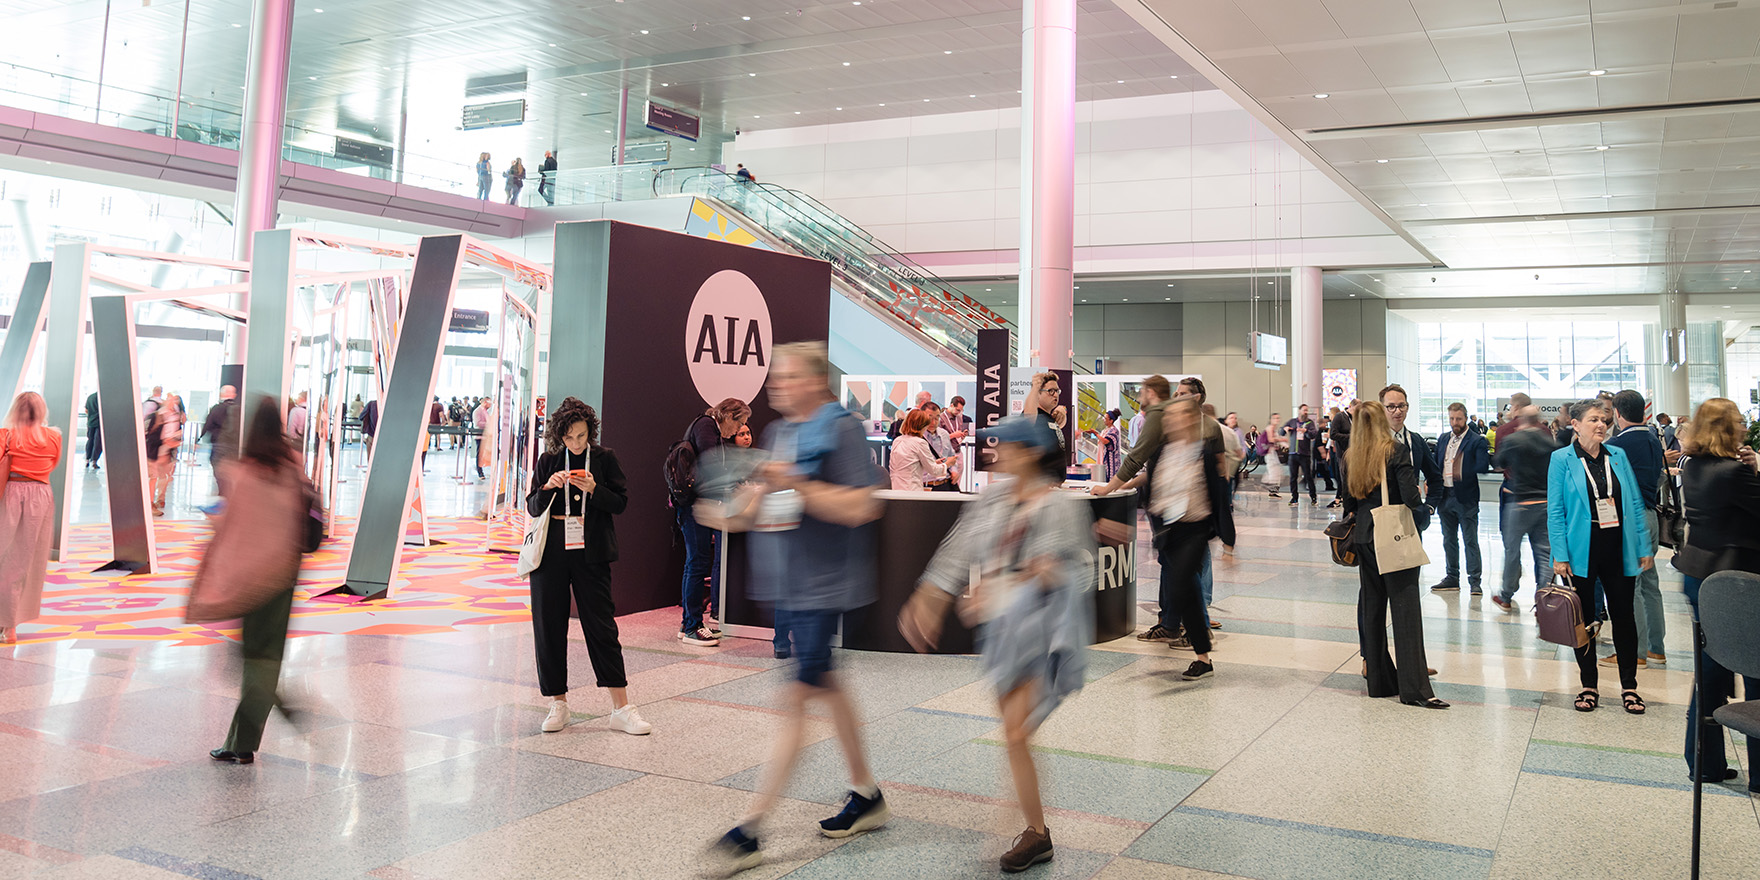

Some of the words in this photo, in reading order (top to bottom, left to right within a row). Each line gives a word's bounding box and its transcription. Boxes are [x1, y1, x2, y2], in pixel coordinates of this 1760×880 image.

[819, 248, 842, 268] LEVEL
[842, 263, 849, 271] 3
[898, 265, 920, 283] LEVEL
[454, 312, 477, 320] Entrance
[692, 314, 766, 367] AIA
[983, 363, 1001, 408] AIA
[982, 412, 1000, 463] Jon
